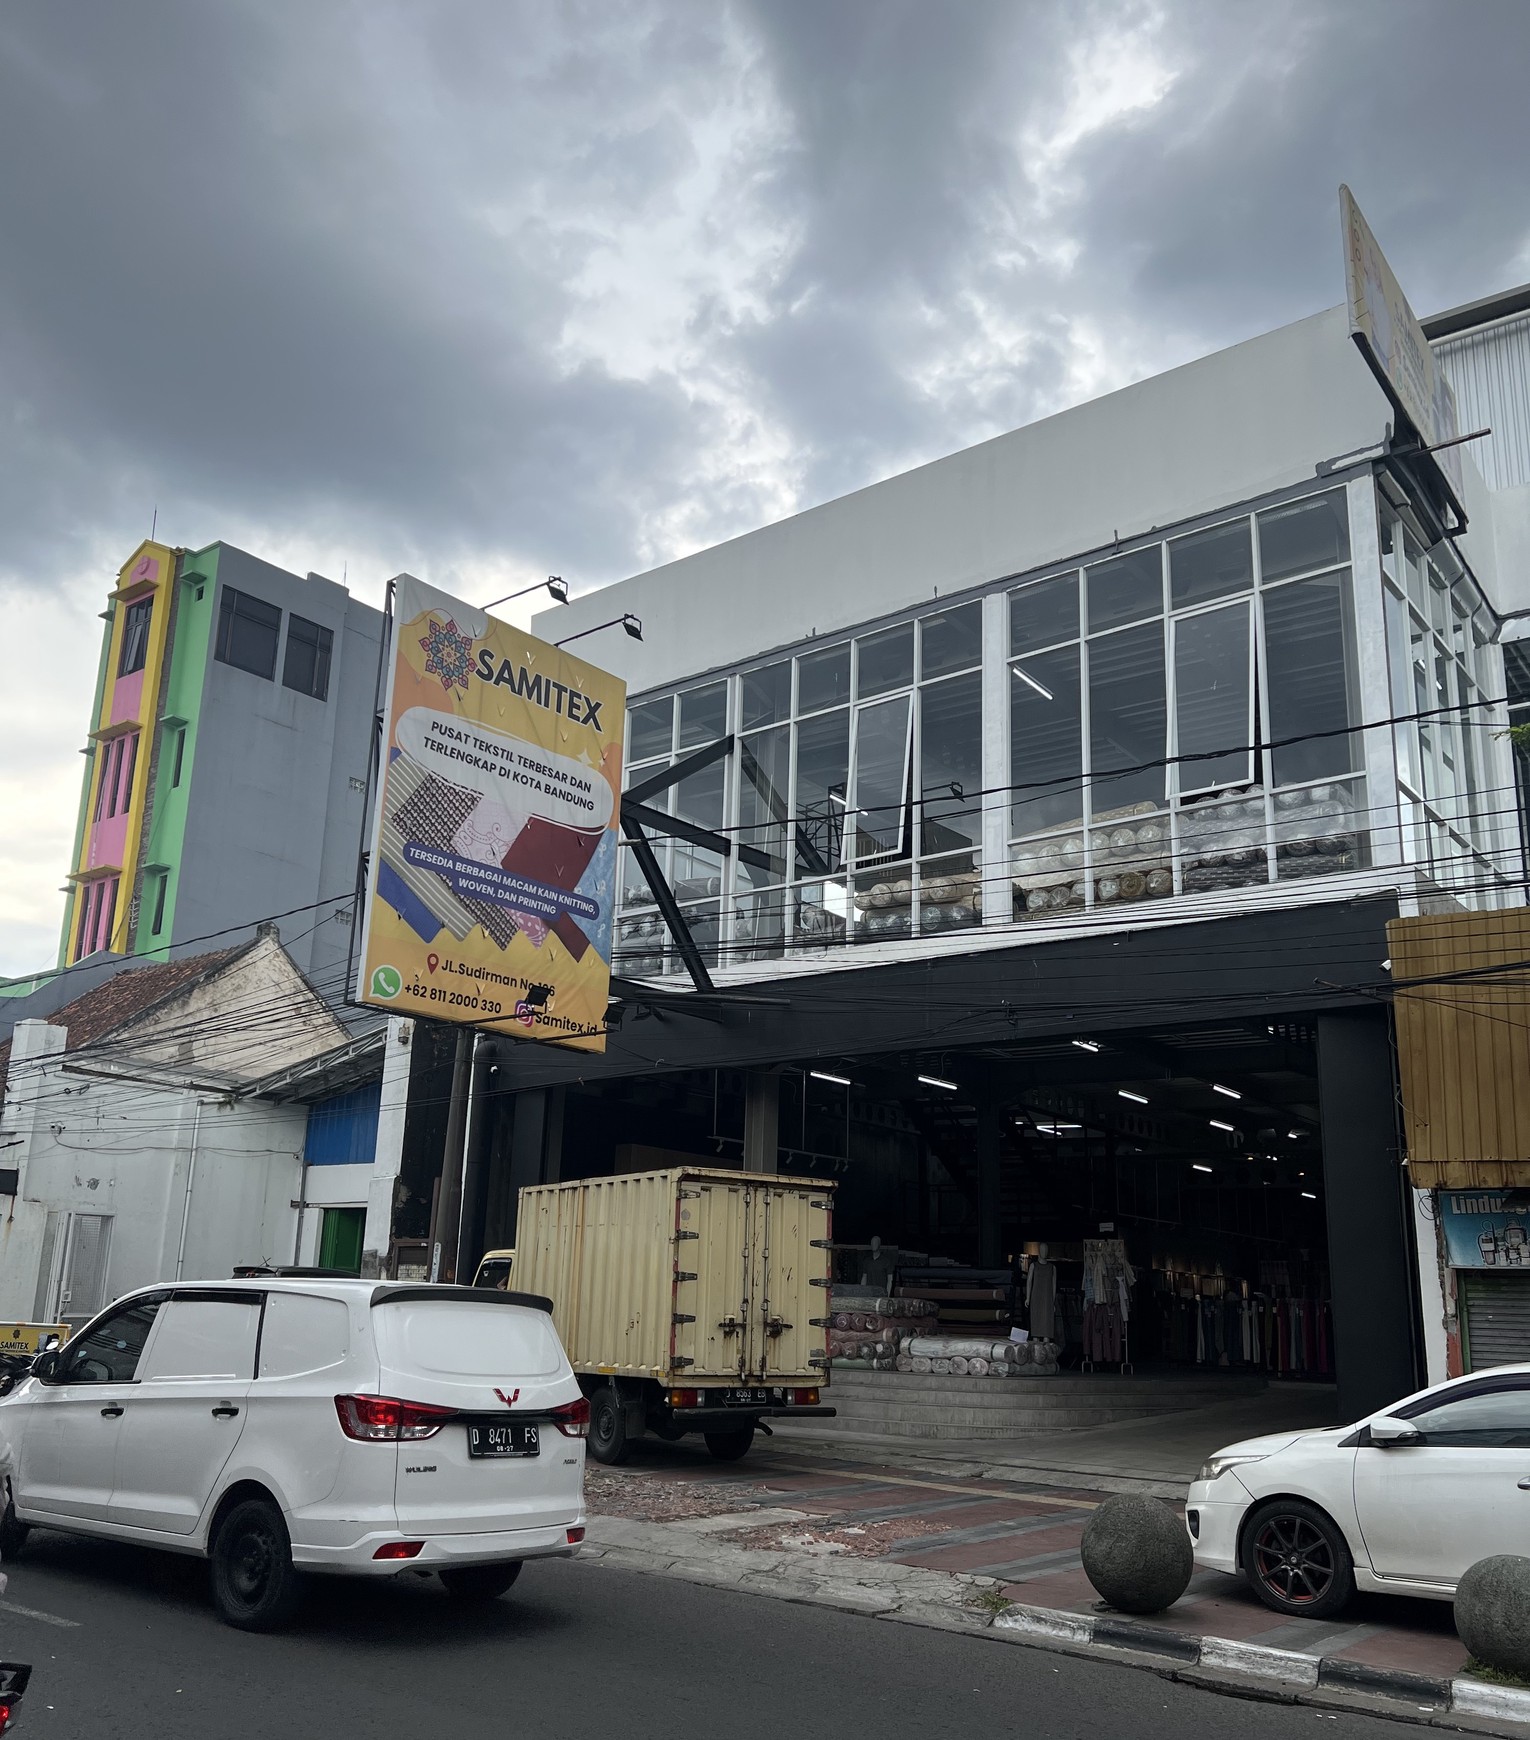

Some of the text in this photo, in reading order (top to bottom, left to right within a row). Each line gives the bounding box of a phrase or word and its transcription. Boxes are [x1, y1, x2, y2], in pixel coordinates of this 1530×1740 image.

[475, 649, 602, 732] SAMITEX
[424, 736, 595, 811] TERLENGKAP DI KOTA BANDUNG
[431, 721, 592, 793] PUSAT TEKSTIL TERBESAR DAN
[409, 847, 596, 915] TERSEDIA BERBAGAI MACAM KAIN KNITTING,
[458, 877, 557, 914] WOVEN, DAN PRINTING
[405, 984, 502, 1014] +62 811 2000 330
[0, 1341, 29, 1350] SAMITEX
[472, 1427, 538, 1444] D 8471 FS
